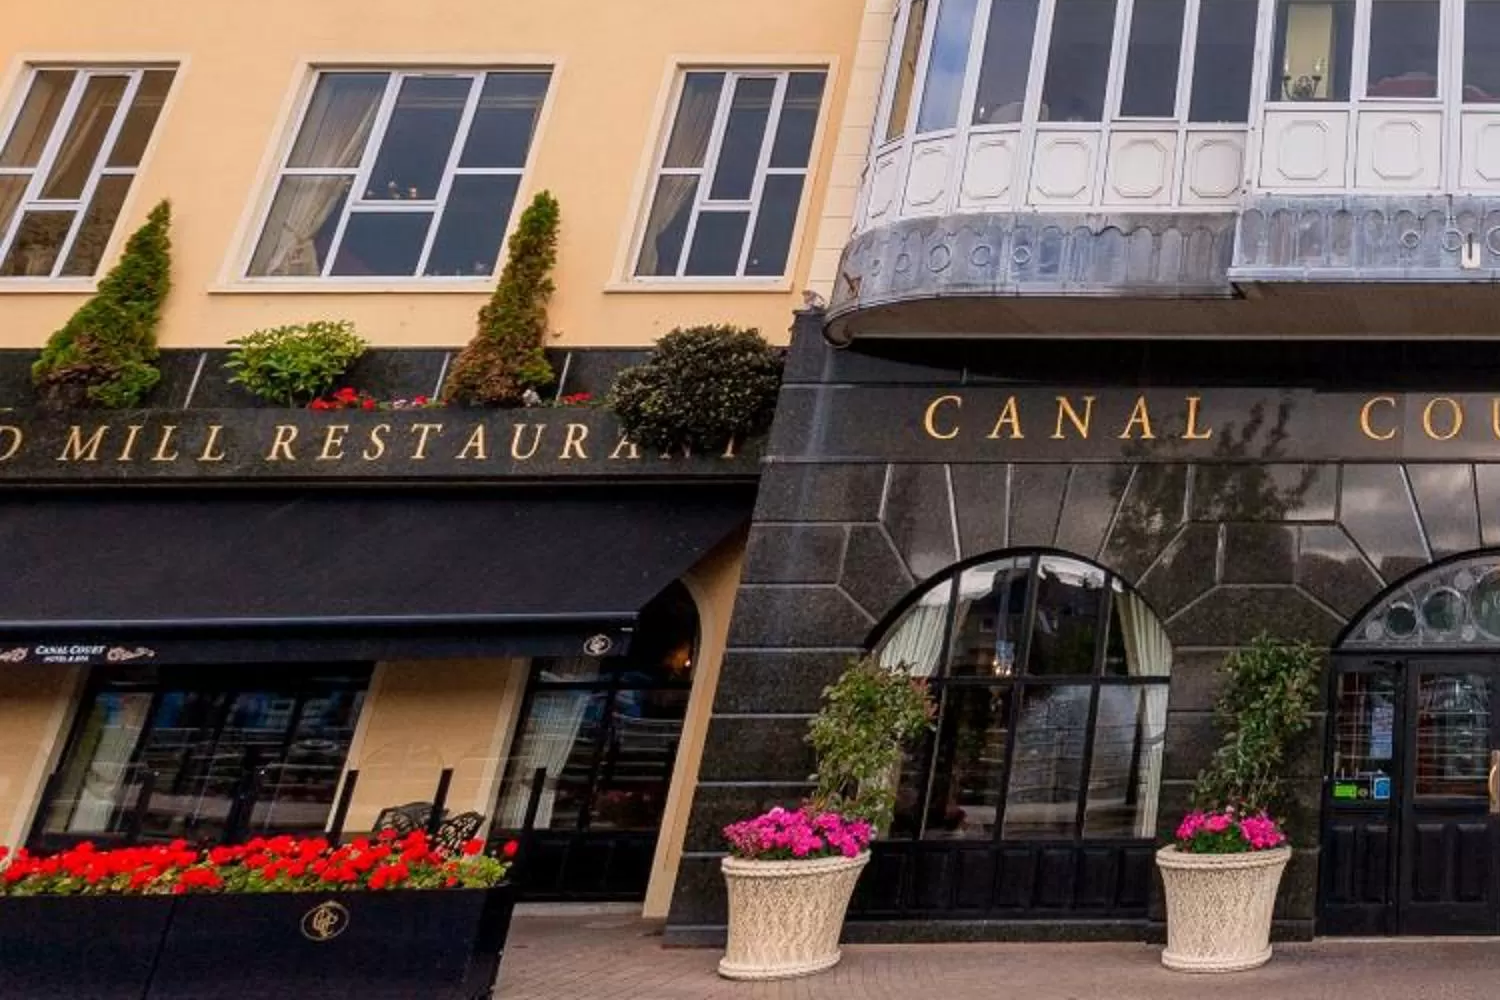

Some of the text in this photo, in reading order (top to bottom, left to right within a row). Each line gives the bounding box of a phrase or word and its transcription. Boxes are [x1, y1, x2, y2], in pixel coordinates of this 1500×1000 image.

[923, 395, 1213, 440] CANAL
[56, 424, 227, 462] MILL
[265, 422, 739, 460] RESTAURA
